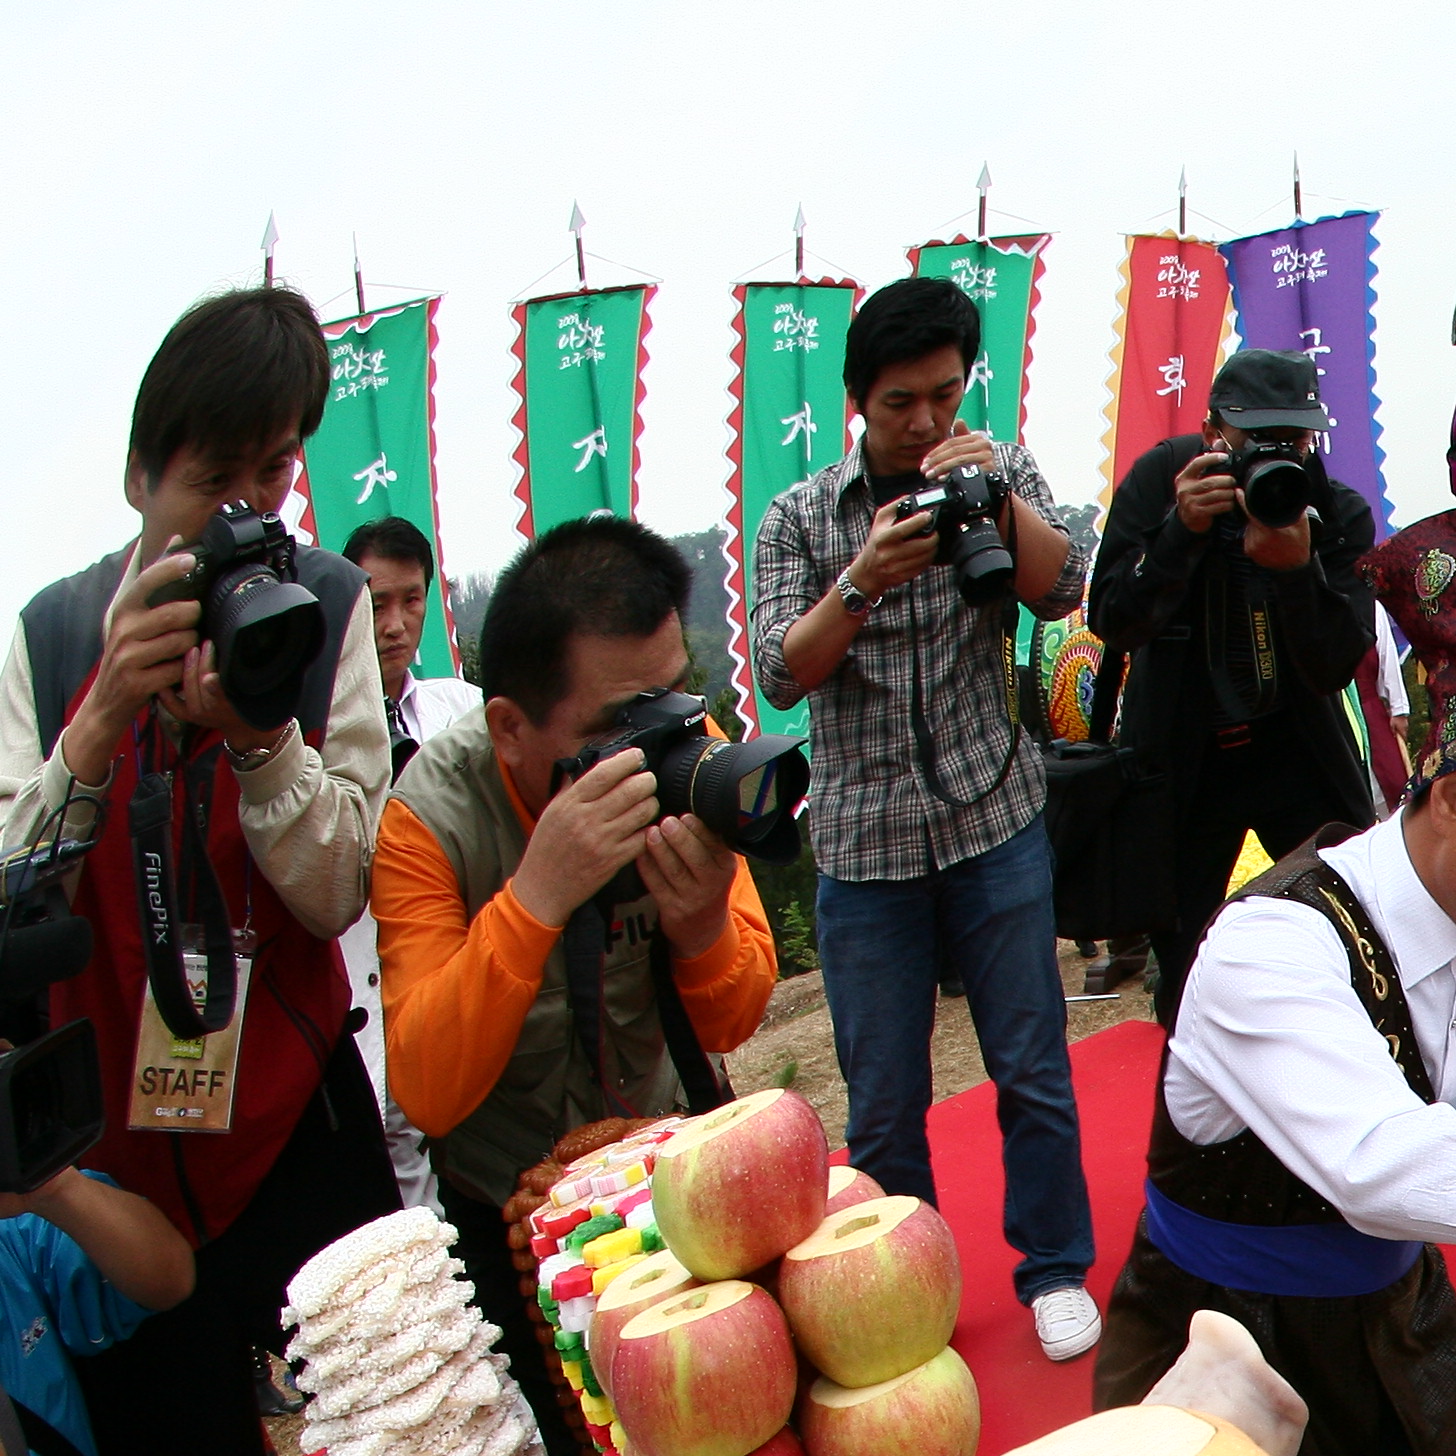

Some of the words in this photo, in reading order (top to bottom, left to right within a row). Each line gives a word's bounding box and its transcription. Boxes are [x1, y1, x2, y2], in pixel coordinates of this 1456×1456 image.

[1155, 353, 1188, 408] 화
[352, 451, 398, 505] 자
[1253, 611, 1268, 649] Nikon
[144, 852, 170, 945] FinePix
[604, 913, 655, 955] FIL
[139, 1066, 226, 1098] STAFF
